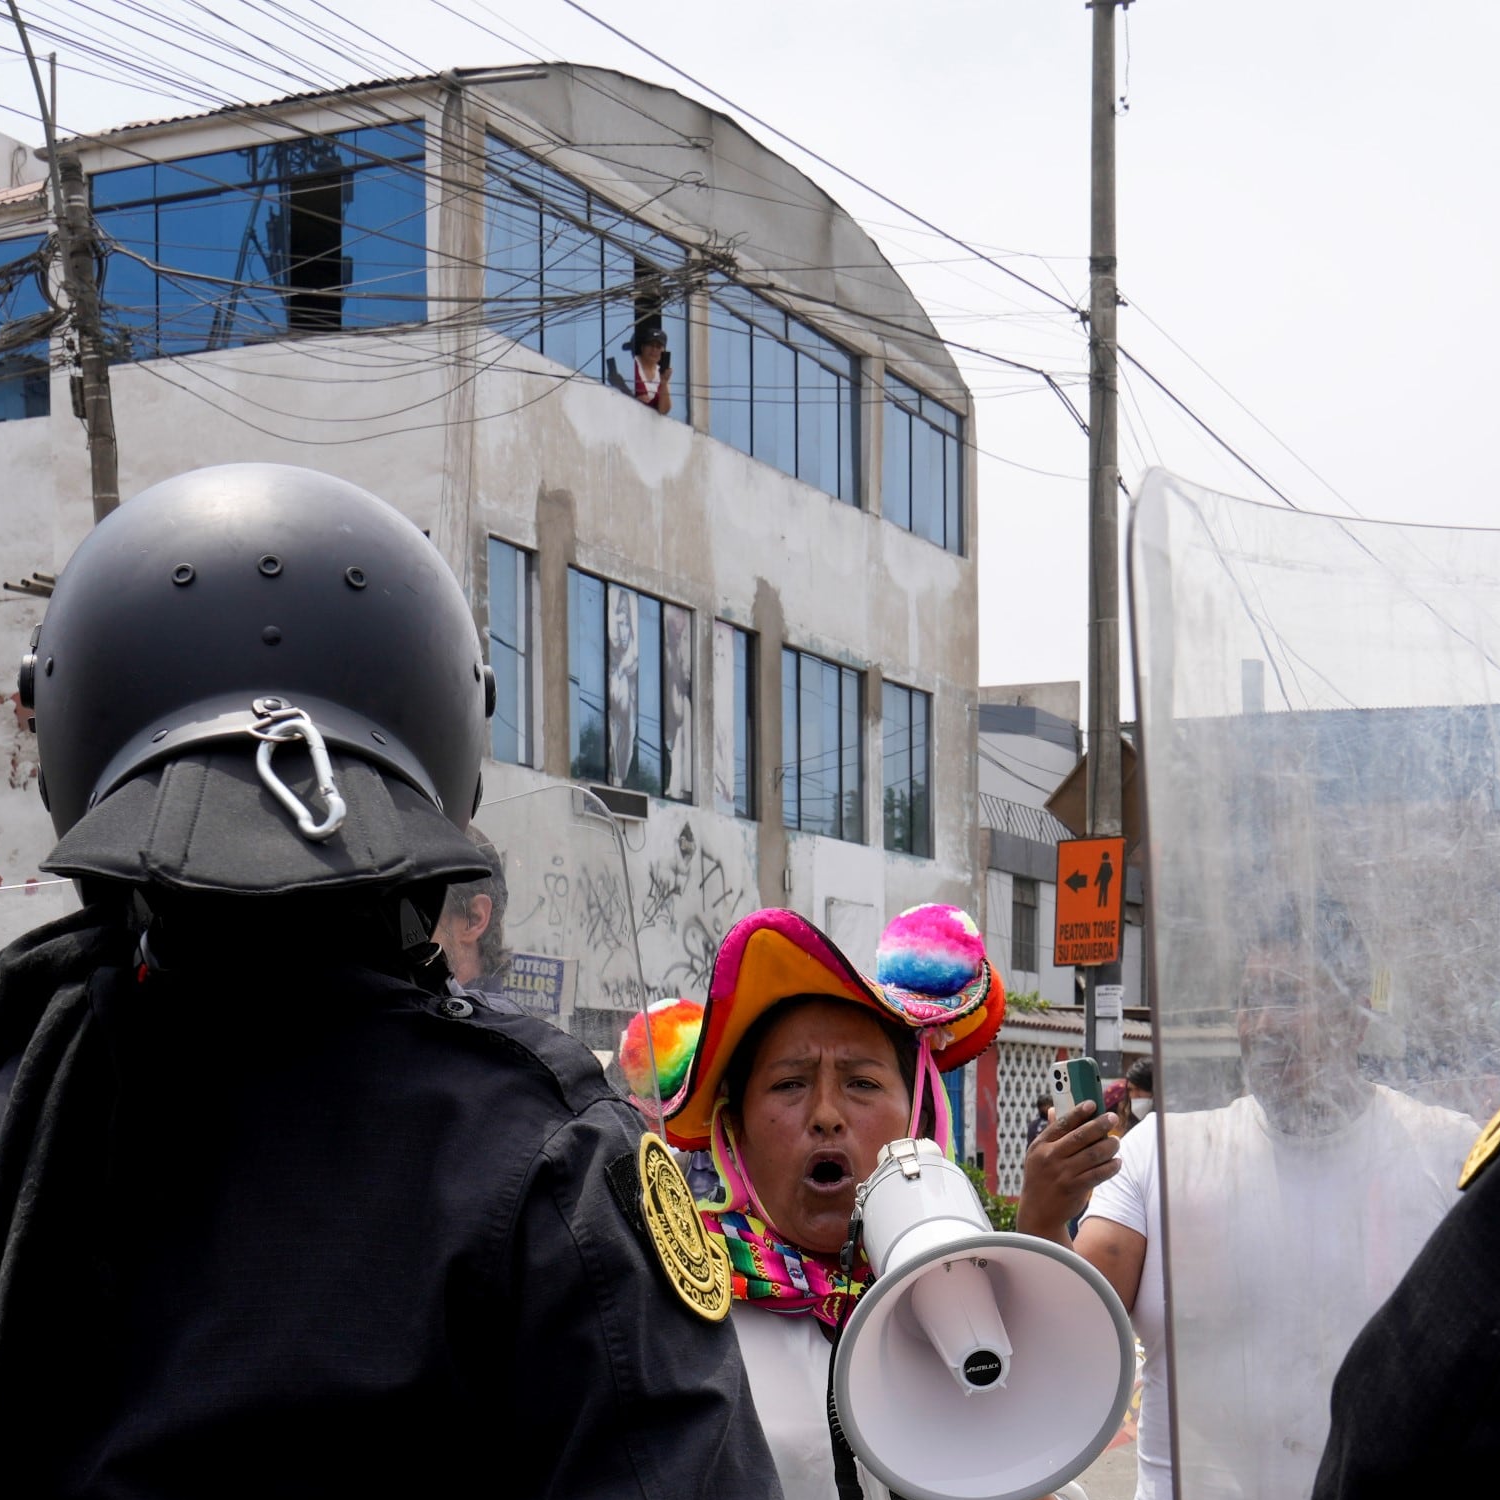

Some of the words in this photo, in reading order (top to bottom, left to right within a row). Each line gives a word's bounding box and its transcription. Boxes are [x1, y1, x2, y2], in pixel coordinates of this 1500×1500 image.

[1059, 922, 1090, 941] PEATON
[1092, 920, 1117, 939] TOME
[1057, 943, 1068, 962] SU
[1071, 942, 1114, 961] IZQUIERDA
